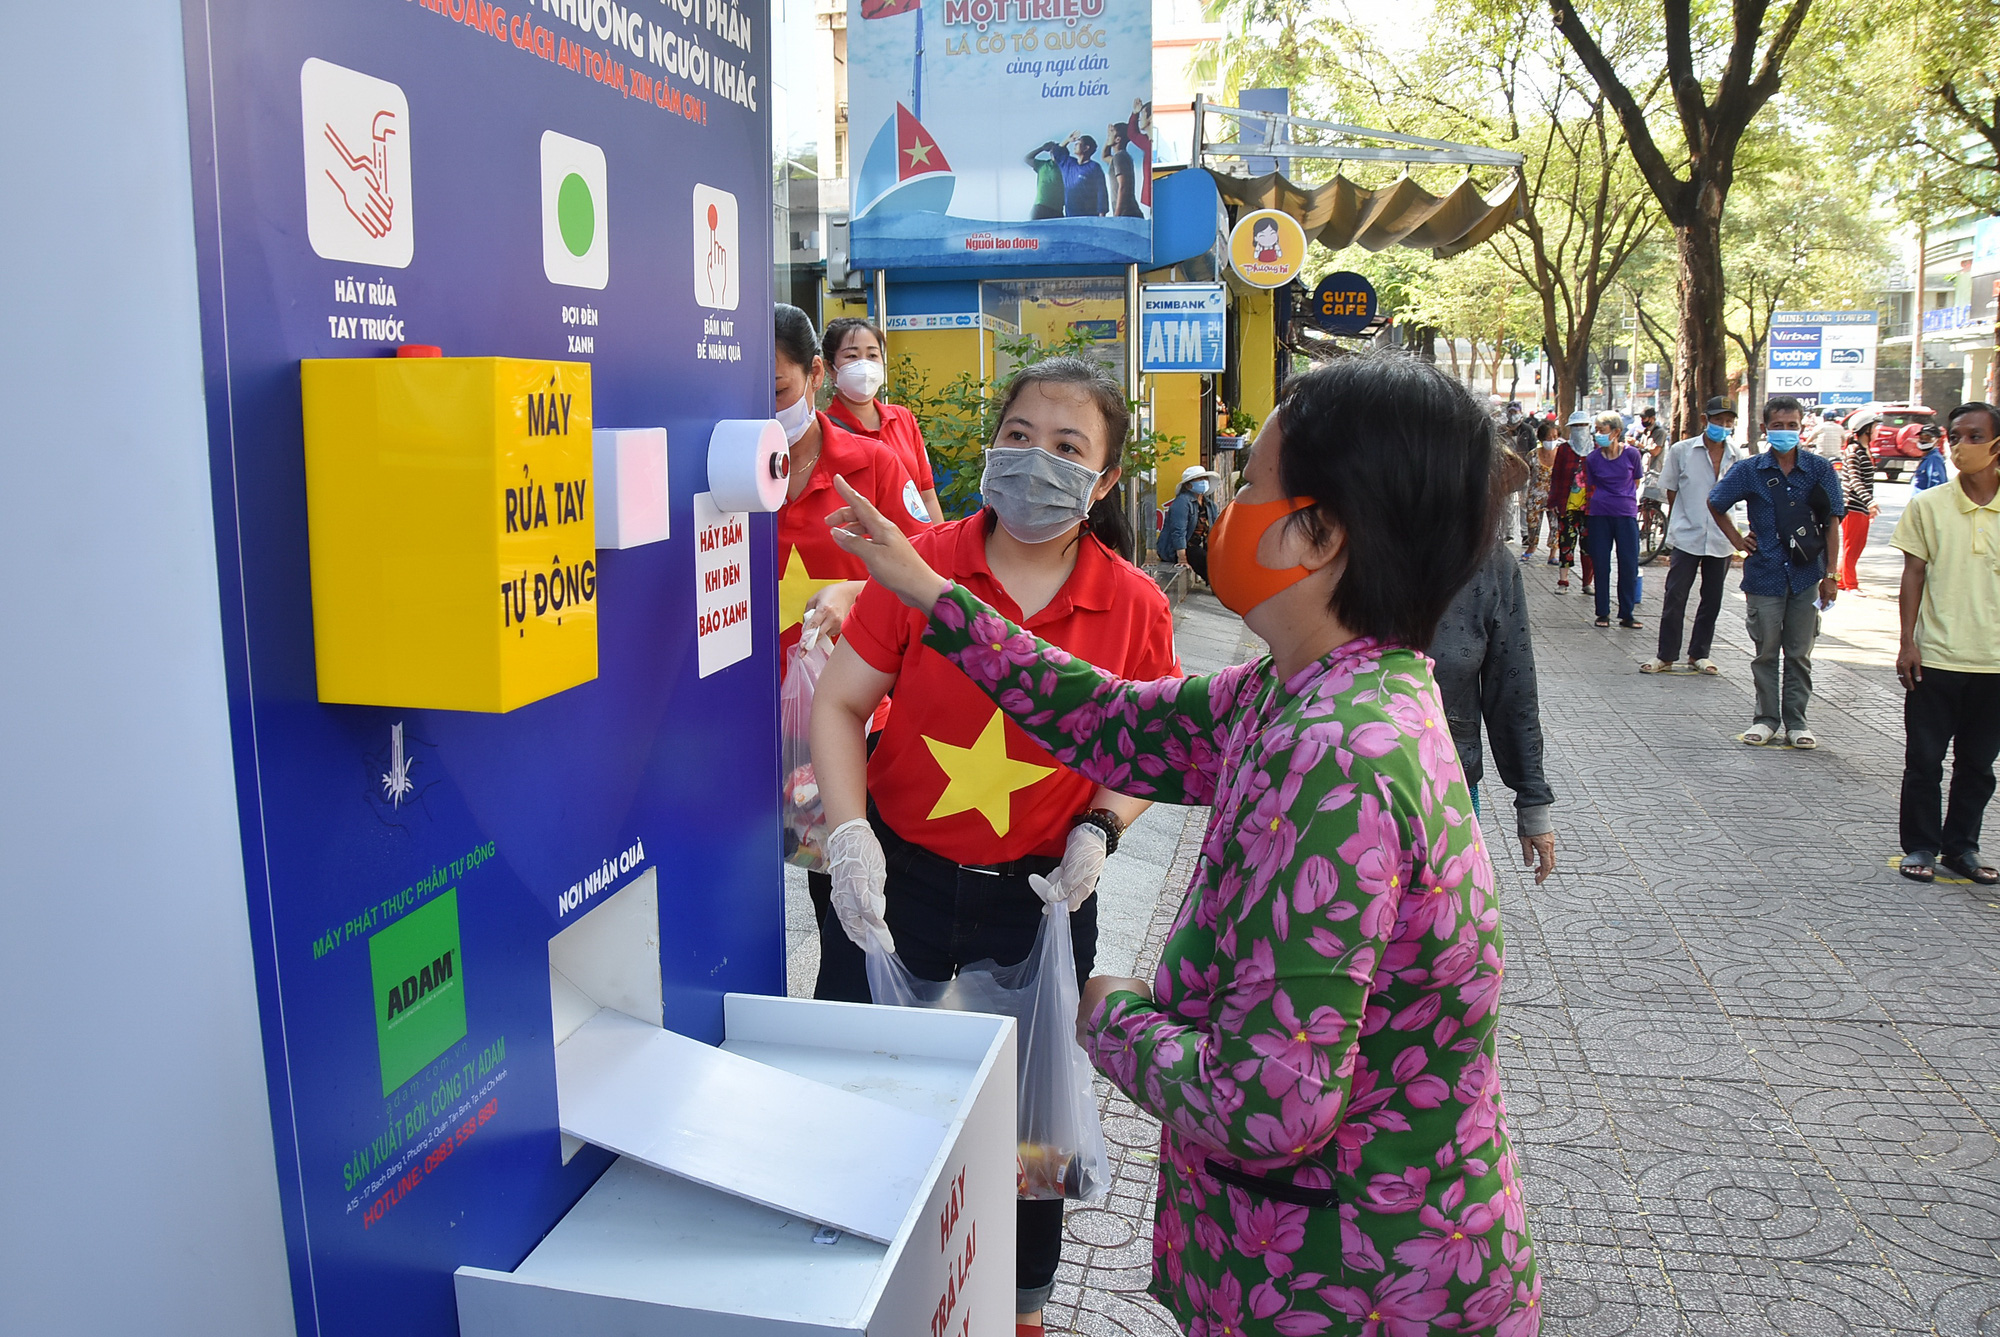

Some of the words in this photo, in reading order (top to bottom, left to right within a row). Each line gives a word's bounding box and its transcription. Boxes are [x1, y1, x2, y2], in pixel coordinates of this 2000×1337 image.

[946, 33, 971, 56] LÁ
[976, 32, 1006, 54] CỜ
[1044, 24, 1106, 51] QUỐC
[510, 12, 555, 62] CÁCH
[557, 37, 581, 73] AN
[583, 49, 628, 99] TOÀN,
[630, 68, 653, 104] XIN
[654, 75, 682, 116] CẢM
[683, 93, 701, 125] ƠN
[648, 21, 710, 90] NGƯỜI
[713, 60, 757, 113] KHÁC
[1006, 57, 1044, 78] cùng
[1045, 56, 1077, 77] ngư
[1078, 53, 1111, 71] dân
[1041, 82, 1076, 98] bám
[995, 237, 1011, 249] lao
[334, 275, 366, 304] HÃY
[368, 276, 397, 307] RỬA
[1145, 300, 1206, 310] EXIMBANK
[1322, 291, 1368, 304] GUTA
[562, 305, 580, 328] ĐỢI
[581, 304, 599, 326] ĐÈN
[886, 318, 907, 327] VISA
[1322, 303, 1367, 316] CAFE
[1806, 314, 1832, 323] LONG
[1834, 313, 1871, 323] TOWER
[328, 315, 358, 340] TAY
[360, 313, 405, 342] TRƯỚC
[704, 313, 720, 336] BẤM
[721, 316, 734, 337] NÚT
[1207, 321, 1220, 338] 24
[1772, 331, 1820, 341] Virbac
[568, 335, 594, 354] XANH
[697, 335, 707, 360] ĐỂ
[708, 340, 727, 363] NHẬN
[728, 342, 742, 361] QUÀ
[1146, 320, 1202, 363] ATM
[1211, 343, 1218, 362] 7
[1773, 350, 1818, 361] brother
[1776, 376, 1813, 387] TEKO
[527, 373, 572, 437] MÁY
[505, 463, 548, 533] RỬA
[554, 478, 586, 525] TAY
[700, 523, 720, 553] HÃY
[722, 515, 743, 547] BẤM
[705, 568, 721, 594] KHI
[722, 559, 740, 588] ĐÈN
[501, 569, 527, 638] TỰ
[534, 554, 596, 627] ĐỘNG
[699, 606, 721, 637] BÁO
[722, 599, 748, 629] XANH
[558, 880, 583, 918] NƠI
[584, 857, 618, 900] NHẬN
[619, 836, 645, 874] QUÀ
[312, 928, 342, 961] MÁY
[345, 907, 378, 941] PHÁT
[380, 886, 415, 920] THỰC
[449, 857, 465, 880] TỰ
[466, 840, 496, 870] ĐỘNG
[388, 949, 453, 1021] ADAM
[343, 1150, 370, 1192] SẢN
[431, 1080, 462, 1117] CÔNG
[462, 1059, 476, 1091] TY
[478, 1035, 506, 1080] ADAM
[363, 1166, 423, 1231] HOTLINE:
[424, 1137, 454, 1174] 0983
[455, 1116, 476, 1148] 558
[478, 1097, 498, 1126] 880
[940, 1163, 966, 1255] HÃY
[958, 1219, 976, 1294] LẠI
